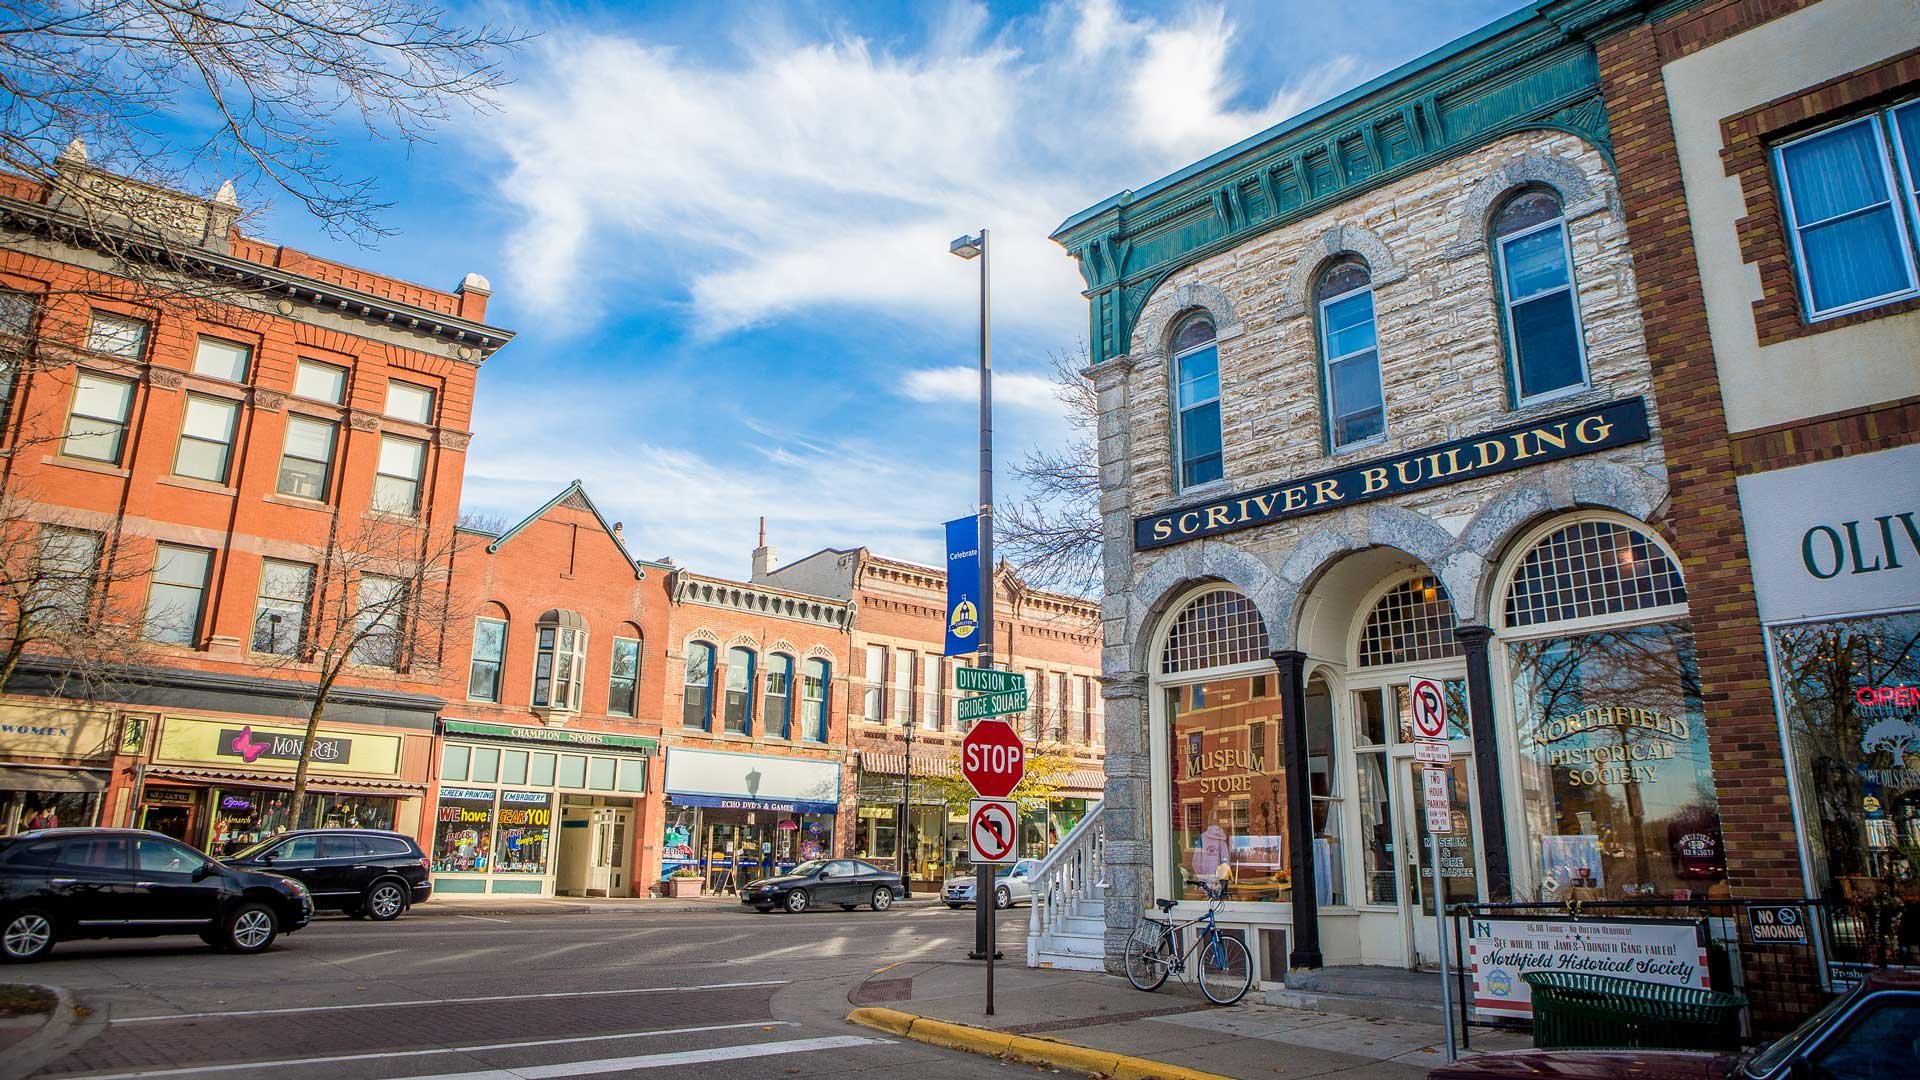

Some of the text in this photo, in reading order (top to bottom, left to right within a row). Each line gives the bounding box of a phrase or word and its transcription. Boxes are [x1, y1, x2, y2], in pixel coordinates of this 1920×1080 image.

[1153, 415, 1614, 541] SCRIVER BUILDING
[950, 549, 977, 560] Celebrate
[960, 670, 1021, 691] DIVISION ST
[959, 691, 1026, 719] BRIDGE SQUARE
[2, 724, 67, 737] WOMEN
[511, 728, 603, 744] CHAMPION SPORTS
[1532, 706, 1690, 754] NORTHFIELD
[271, 736, 339, 760] MONRCH
[1178, 743, 1198, 755] THE
[1549, 741, 1675, 766] HISTORICAL
[966, 743, 1020, 774] STOP
[1186, 749, 1266, 779] MUSEUM
[1569, 766, 1658, 786] SOCIETY
[1200, 776, 1252, 794] STORE
[1428, 787, 1443, 797] HOUR
[440, 789, 494, 800] SCREEN PRINTING
[504, 792, 545, 801] EMBROIDERY
[721, 800, 741, 808] ECHO
[771, 803, 794, 811] GAMES
[1427, 799, 1447, 810] PARKING
[439, 807, 461, 822] WE
[461, 808, 487, 822] have
[498, 809, 525, 824] GEAR
[527, 809, 550, 825] YOU
[1423, 837, 1467, 848] MSEUM
[1442, 847, 1451, 858] &
[1421, 867, 1474, 878] ENRANCE
[1757, 910, 1774, 924] NO
[1754, 924, 1804, 939] SMOKING
[1482, 947, 1694, 985] Northfield Historical Society
